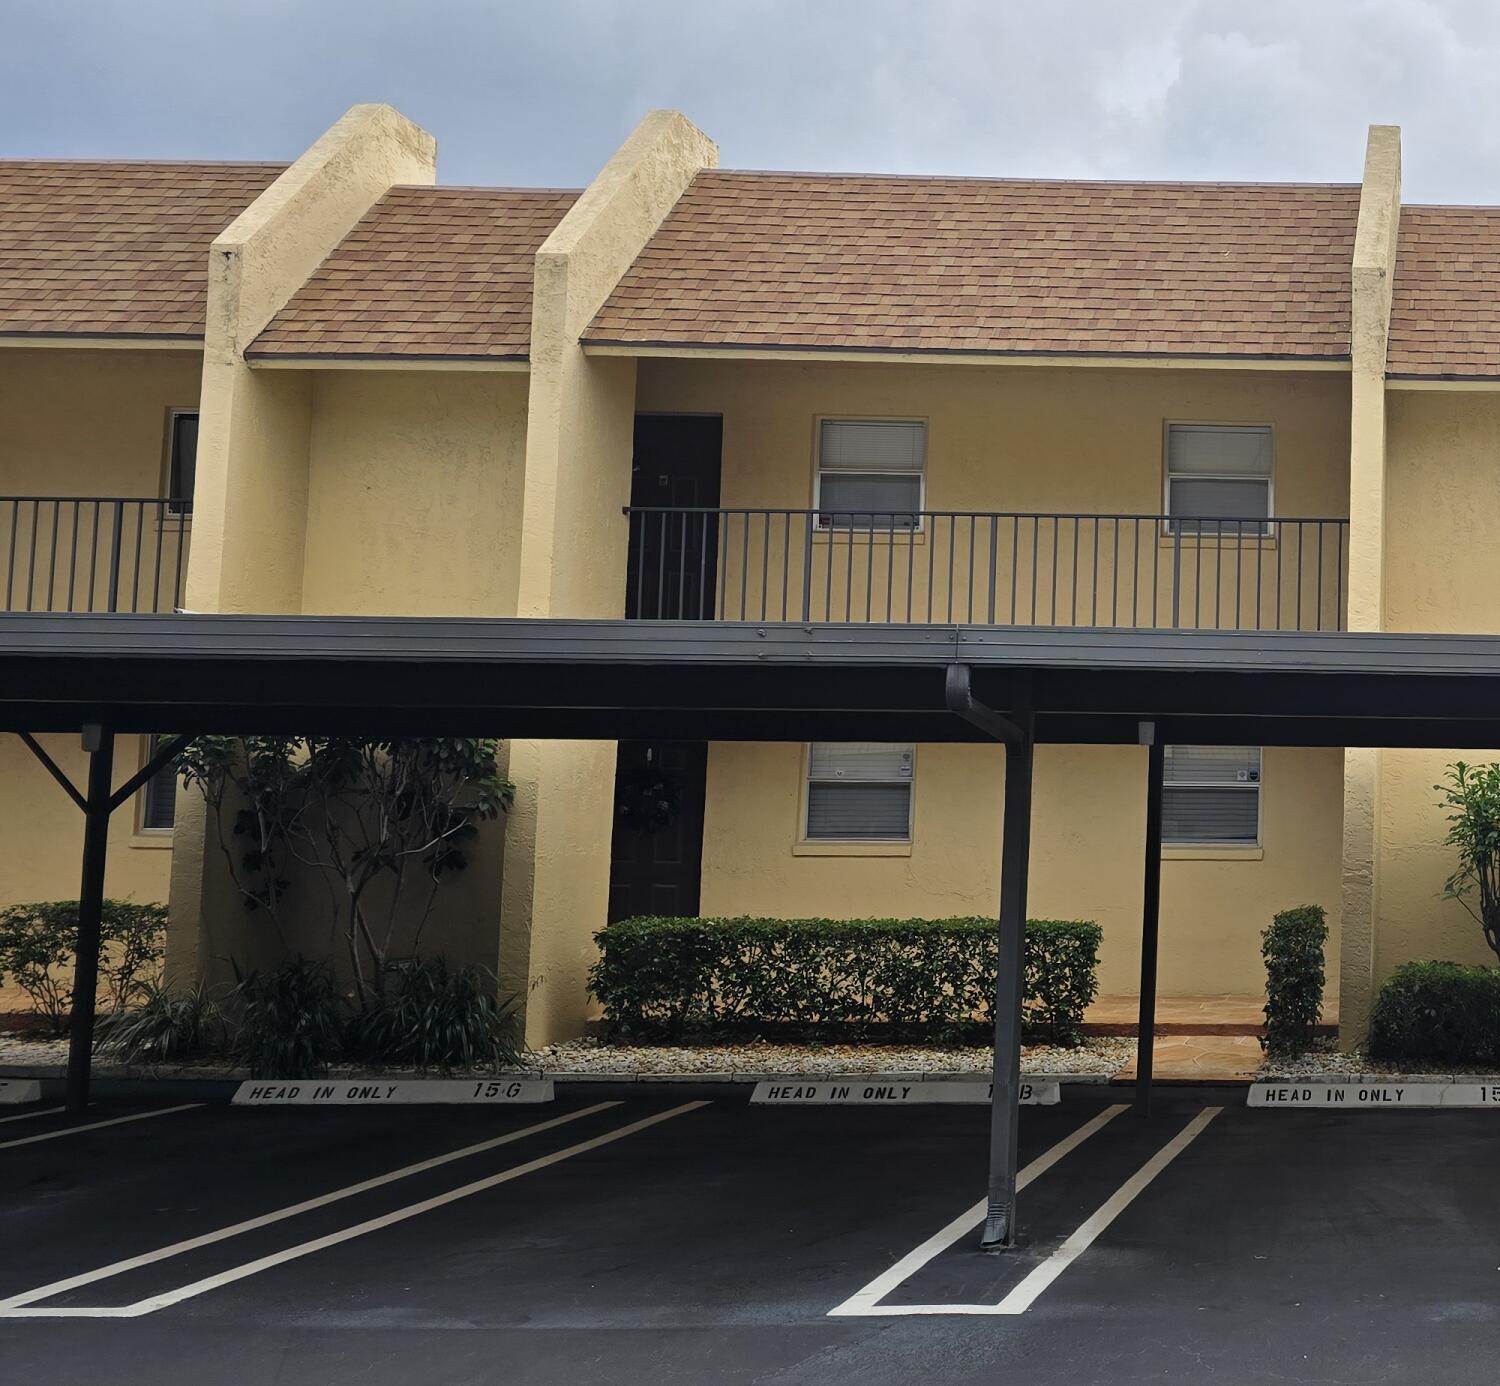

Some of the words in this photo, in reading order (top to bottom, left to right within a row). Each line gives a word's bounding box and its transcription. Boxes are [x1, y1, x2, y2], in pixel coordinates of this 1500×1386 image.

[249, 1087, 301, 1099] HEAD
[312, 1086, 335, 1099] IN
[346, 1086, 398, 1099] ONLY
[768, 1086, 817, 1099] HEAD
[830, 1086, 850, 1099] IN
[863, 1086, 911, 1100] ONLY
[1265, 1089, 1313, 1102] HEAD
[1326, 1089, 1345, 1102] IN
[1358, 1089, 1405, 1102] ONLY
